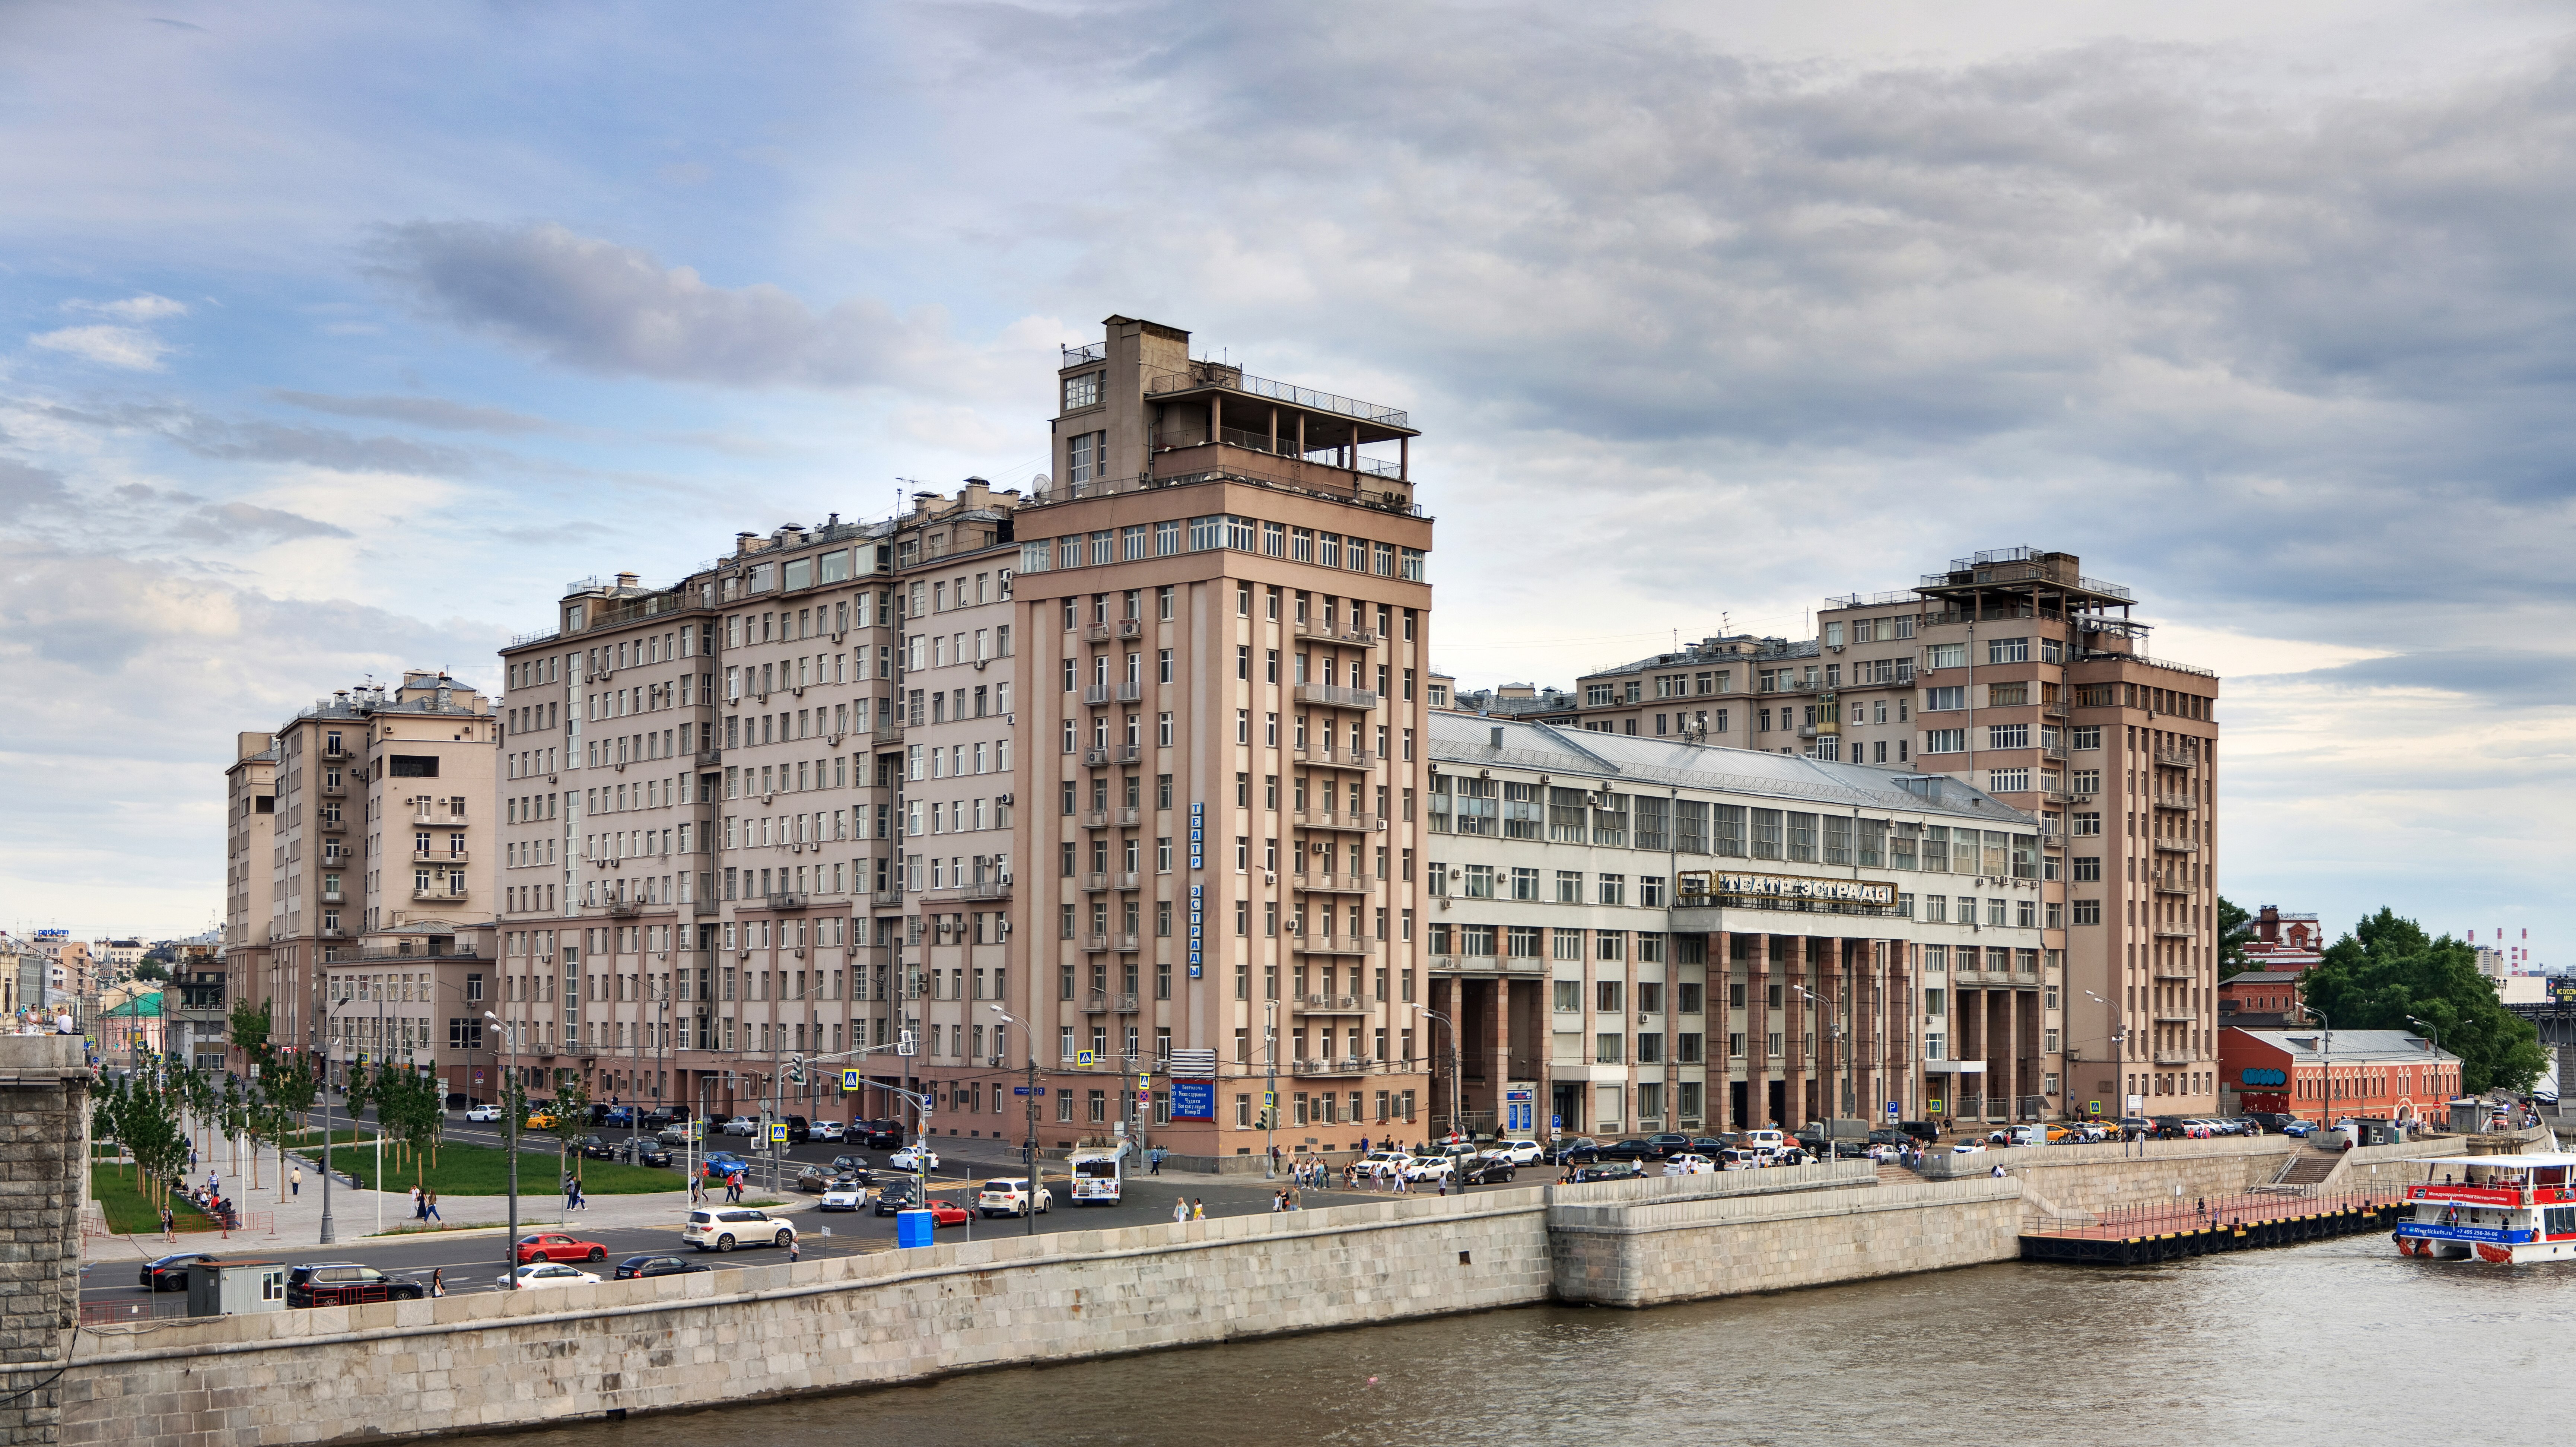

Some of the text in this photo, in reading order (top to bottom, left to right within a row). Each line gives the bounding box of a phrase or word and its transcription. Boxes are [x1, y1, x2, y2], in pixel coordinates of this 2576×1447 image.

[1192, 805, 1200, 866] ТЕАТР
[1724, 876, 1892, 905] ТЕАТР ЭСТРАДЫ
[38, 929, 55, 937] park
[1190, 887, 1200, 976] ЭСТРАДЫ
[1890, 1103, 1895, 1111] P
[1554, 1117, 1559, 1126] P
